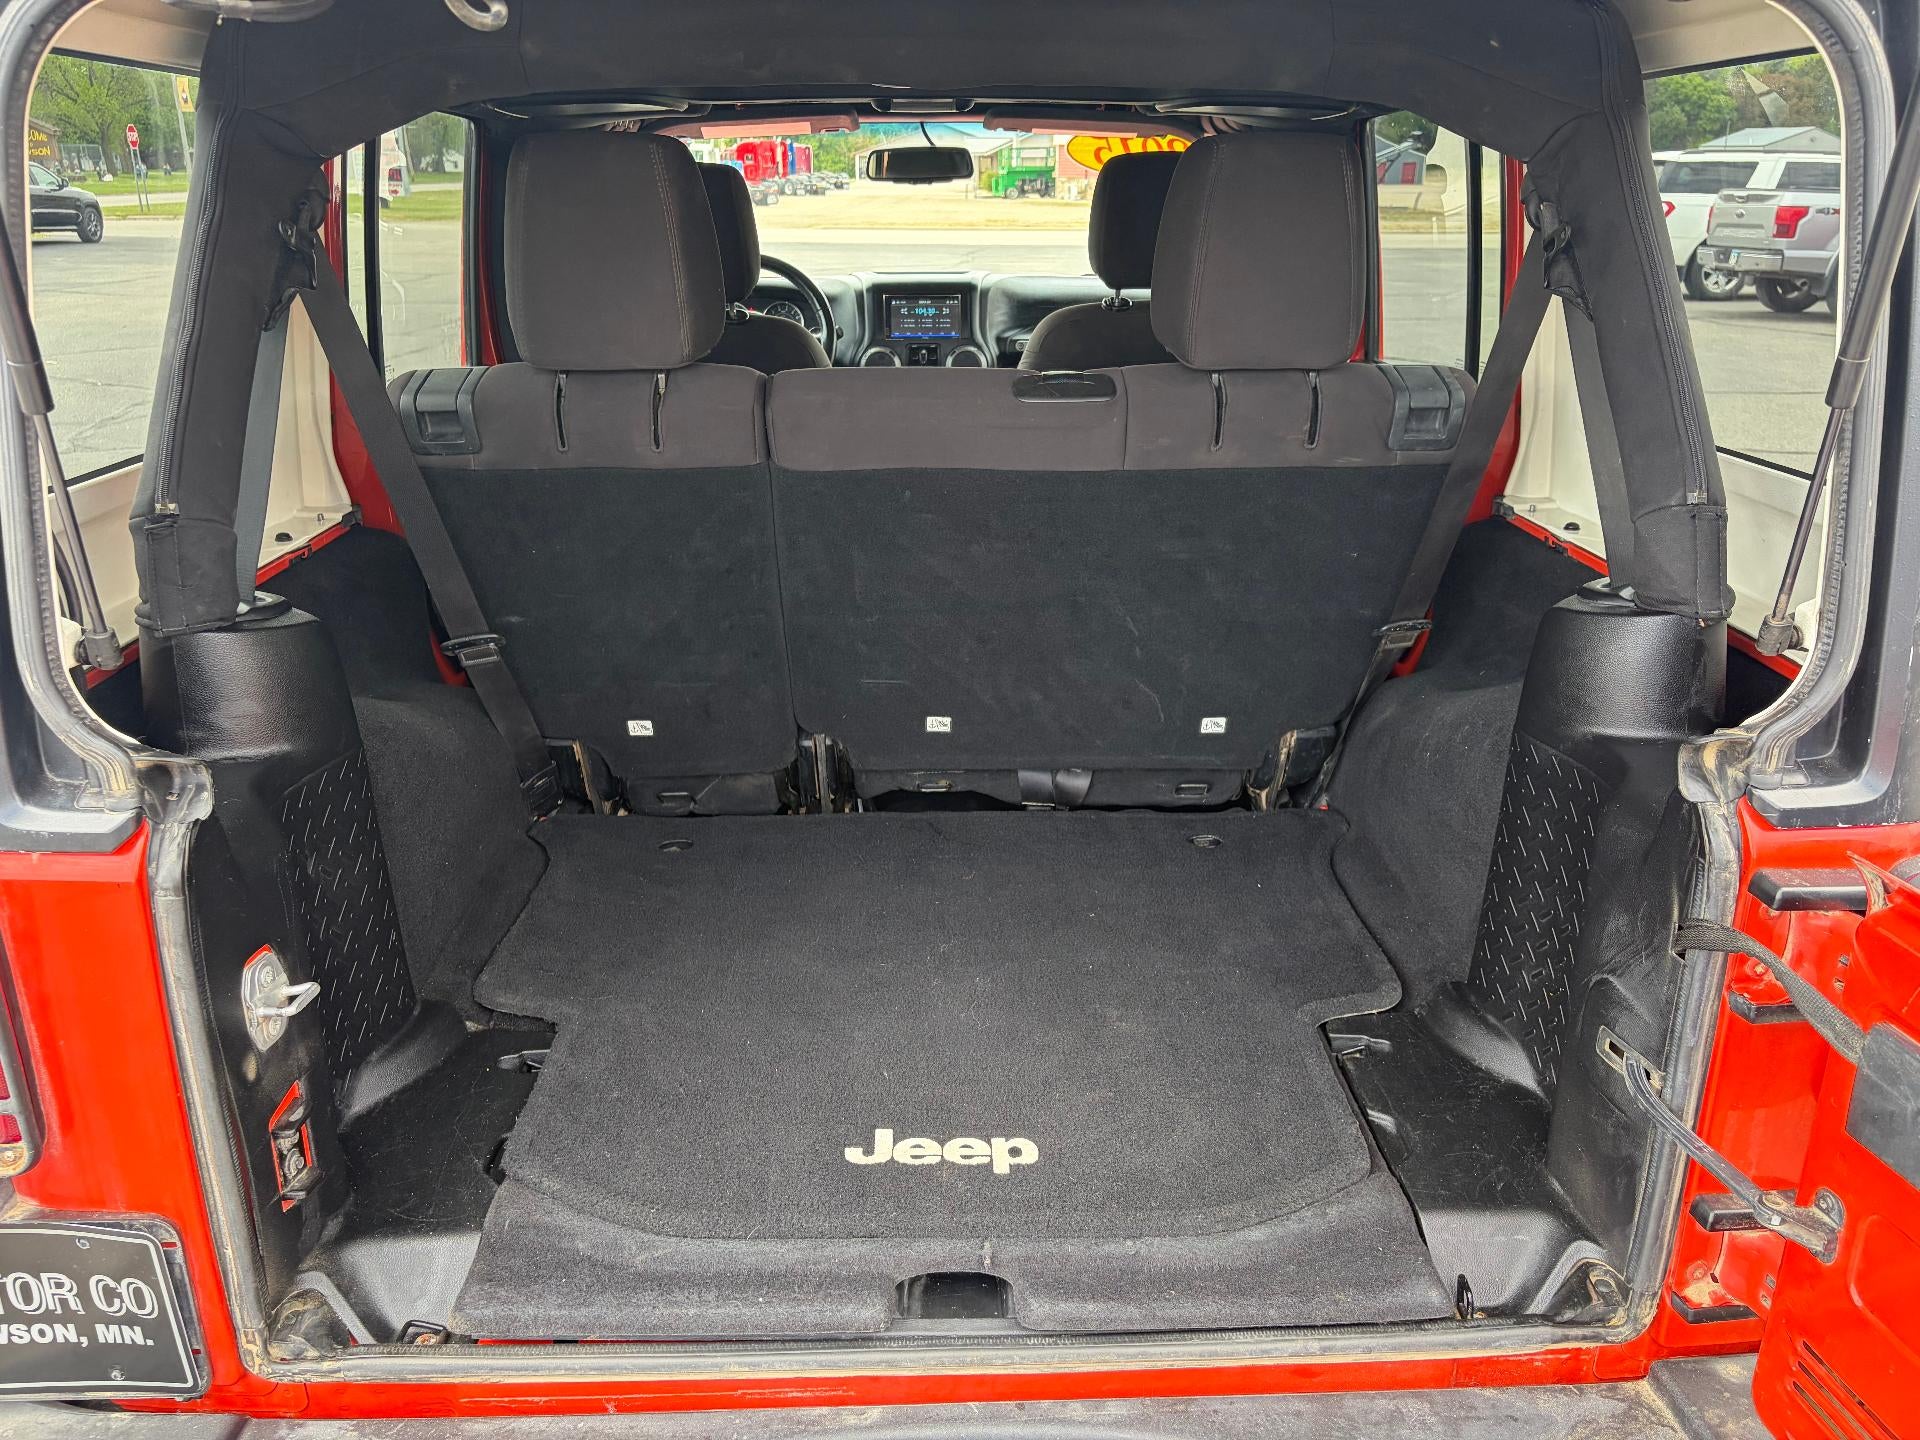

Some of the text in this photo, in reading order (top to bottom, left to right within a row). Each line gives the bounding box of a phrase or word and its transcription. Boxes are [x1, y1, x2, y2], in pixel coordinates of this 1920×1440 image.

[844, 1128, 1039, 1174] Jeep
[0, 1271, 159, 1319] OR CO
[0, 1323, 155, 1347] SON, MN.
